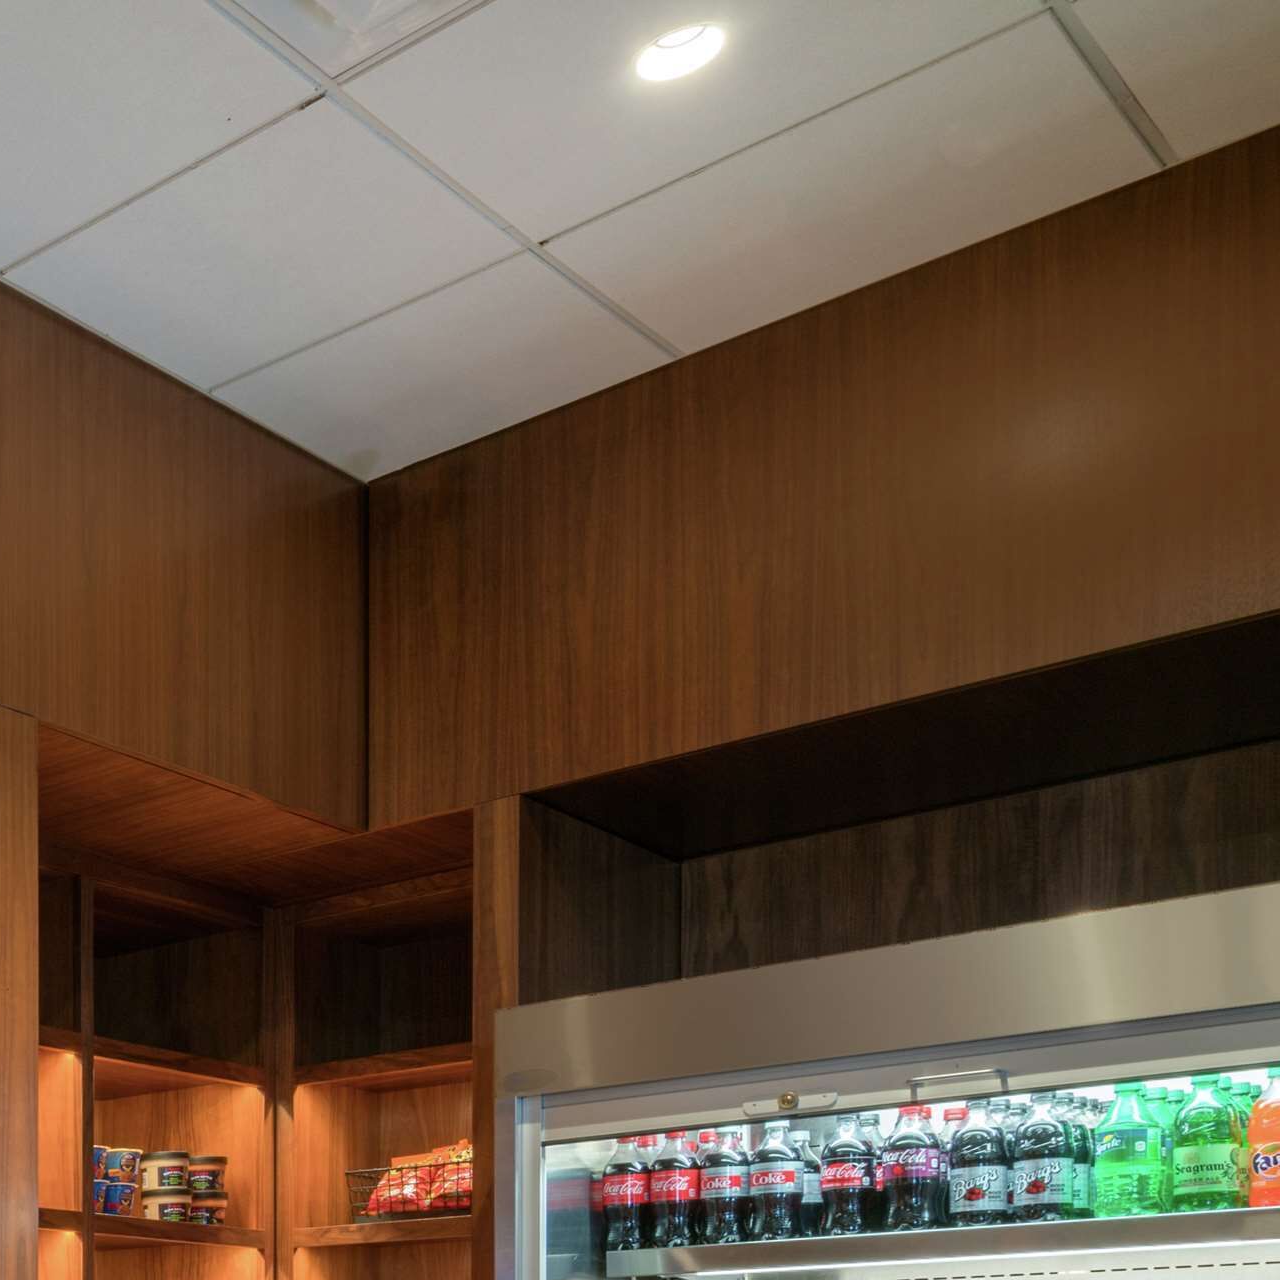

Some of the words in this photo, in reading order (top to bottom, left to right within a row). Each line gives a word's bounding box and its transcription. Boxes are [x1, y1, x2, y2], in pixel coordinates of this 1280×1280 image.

[1175, 1161, 1232, 1176] Seagram's
[701, 1177, 731, 1191] Coke
[752, 1173, 787, 1186] Coke
[953, 1167, 999, 1202] Barq's
[1015, 1160, 1061, 1194] Barq's
